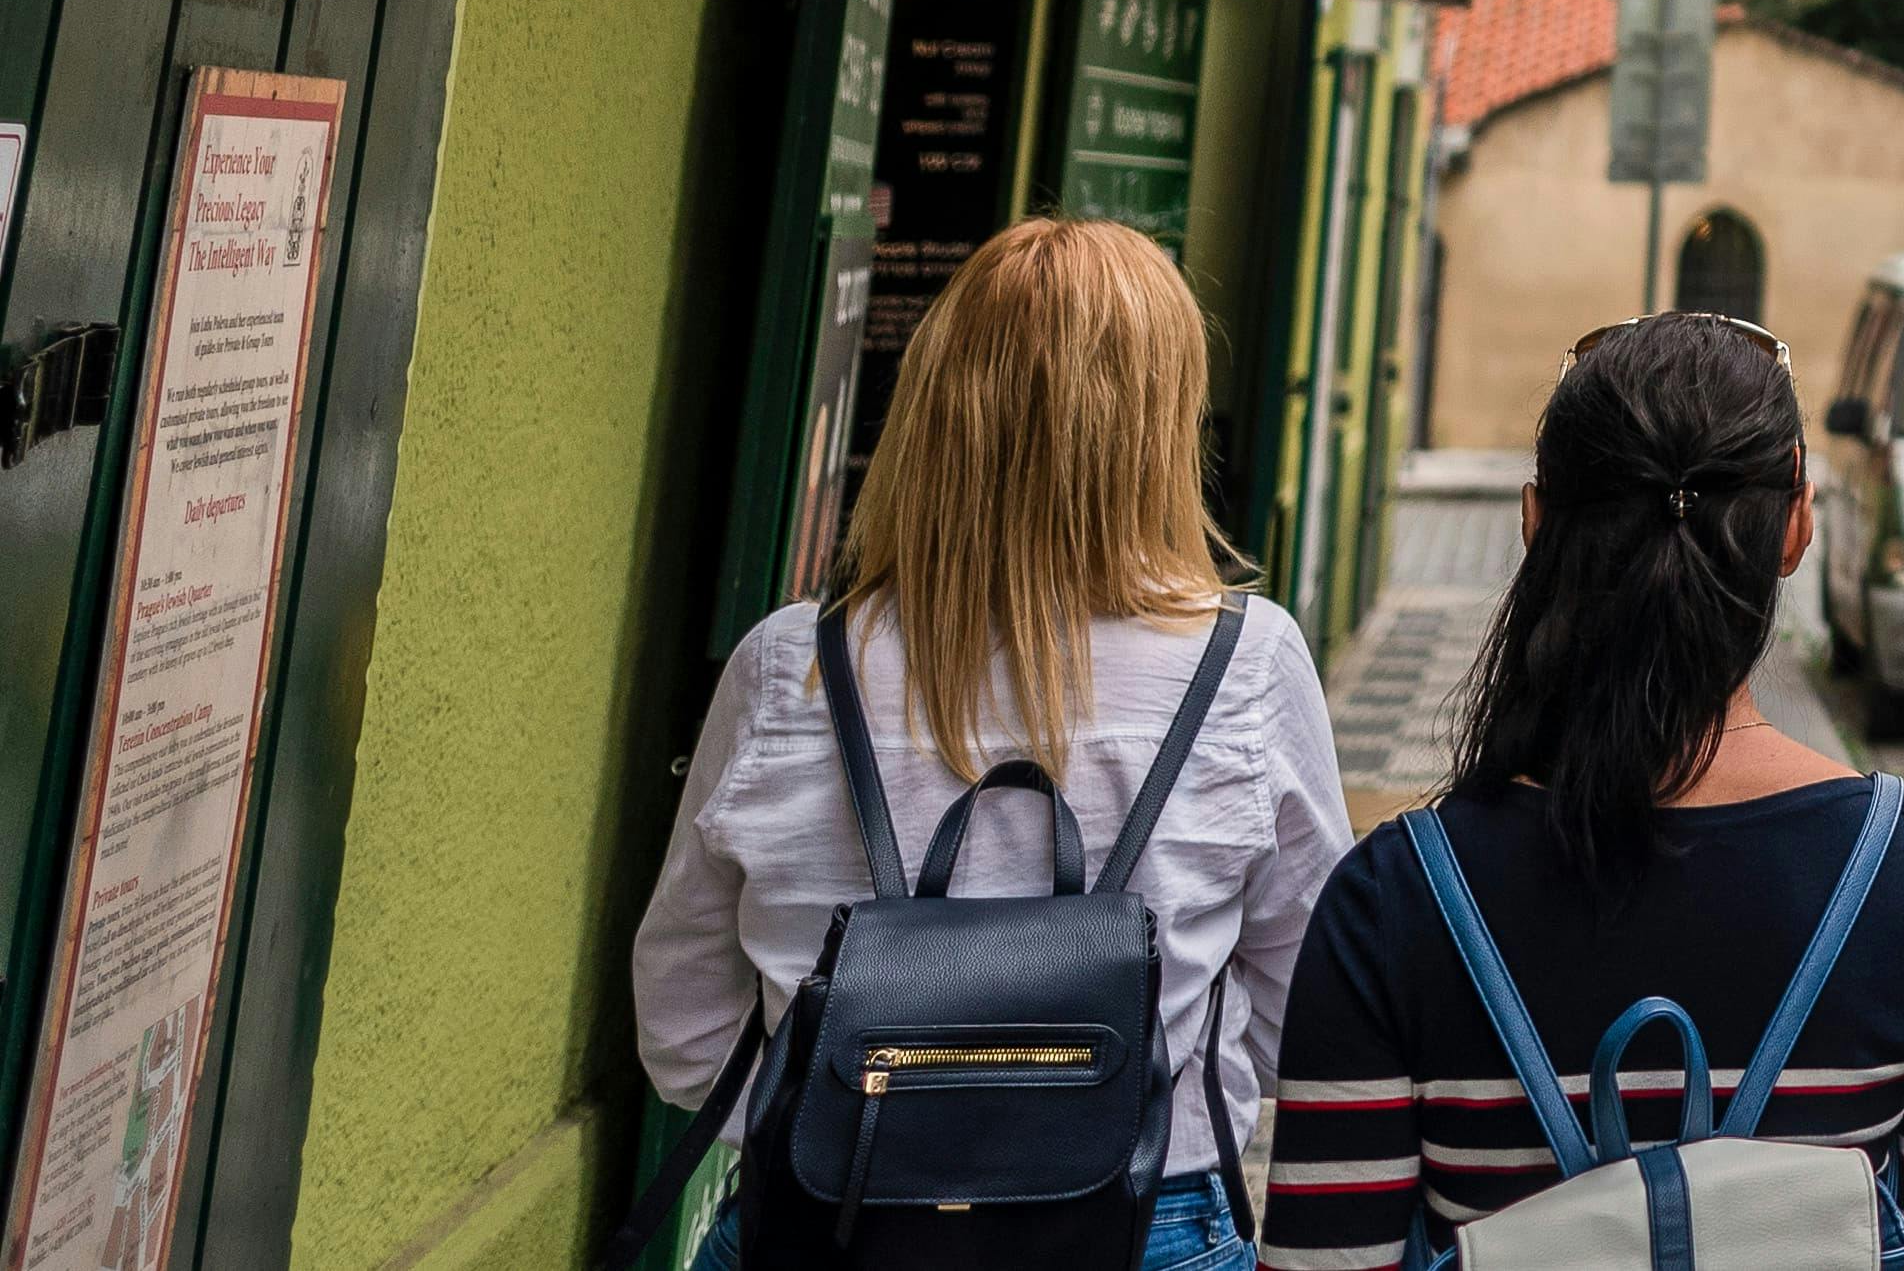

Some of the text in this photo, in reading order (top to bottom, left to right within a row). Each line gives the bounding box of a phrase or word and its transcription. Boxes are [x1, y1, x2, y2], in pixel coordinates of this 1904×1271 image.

[202, 144, 277, 183] Experience Your
[195, 193, 267, 231] Precious Legacy
[188, 238, 277, 278] The Intelligent Way
[184, 493, 246, 526] Daily departures
[164, 586, 188, 610] Jewish
[186, 583, 213, 609] Quarter
[117, 705, 212, 754] Terezin Concentration Camp
[92, 878, 138, 910] Private tours
